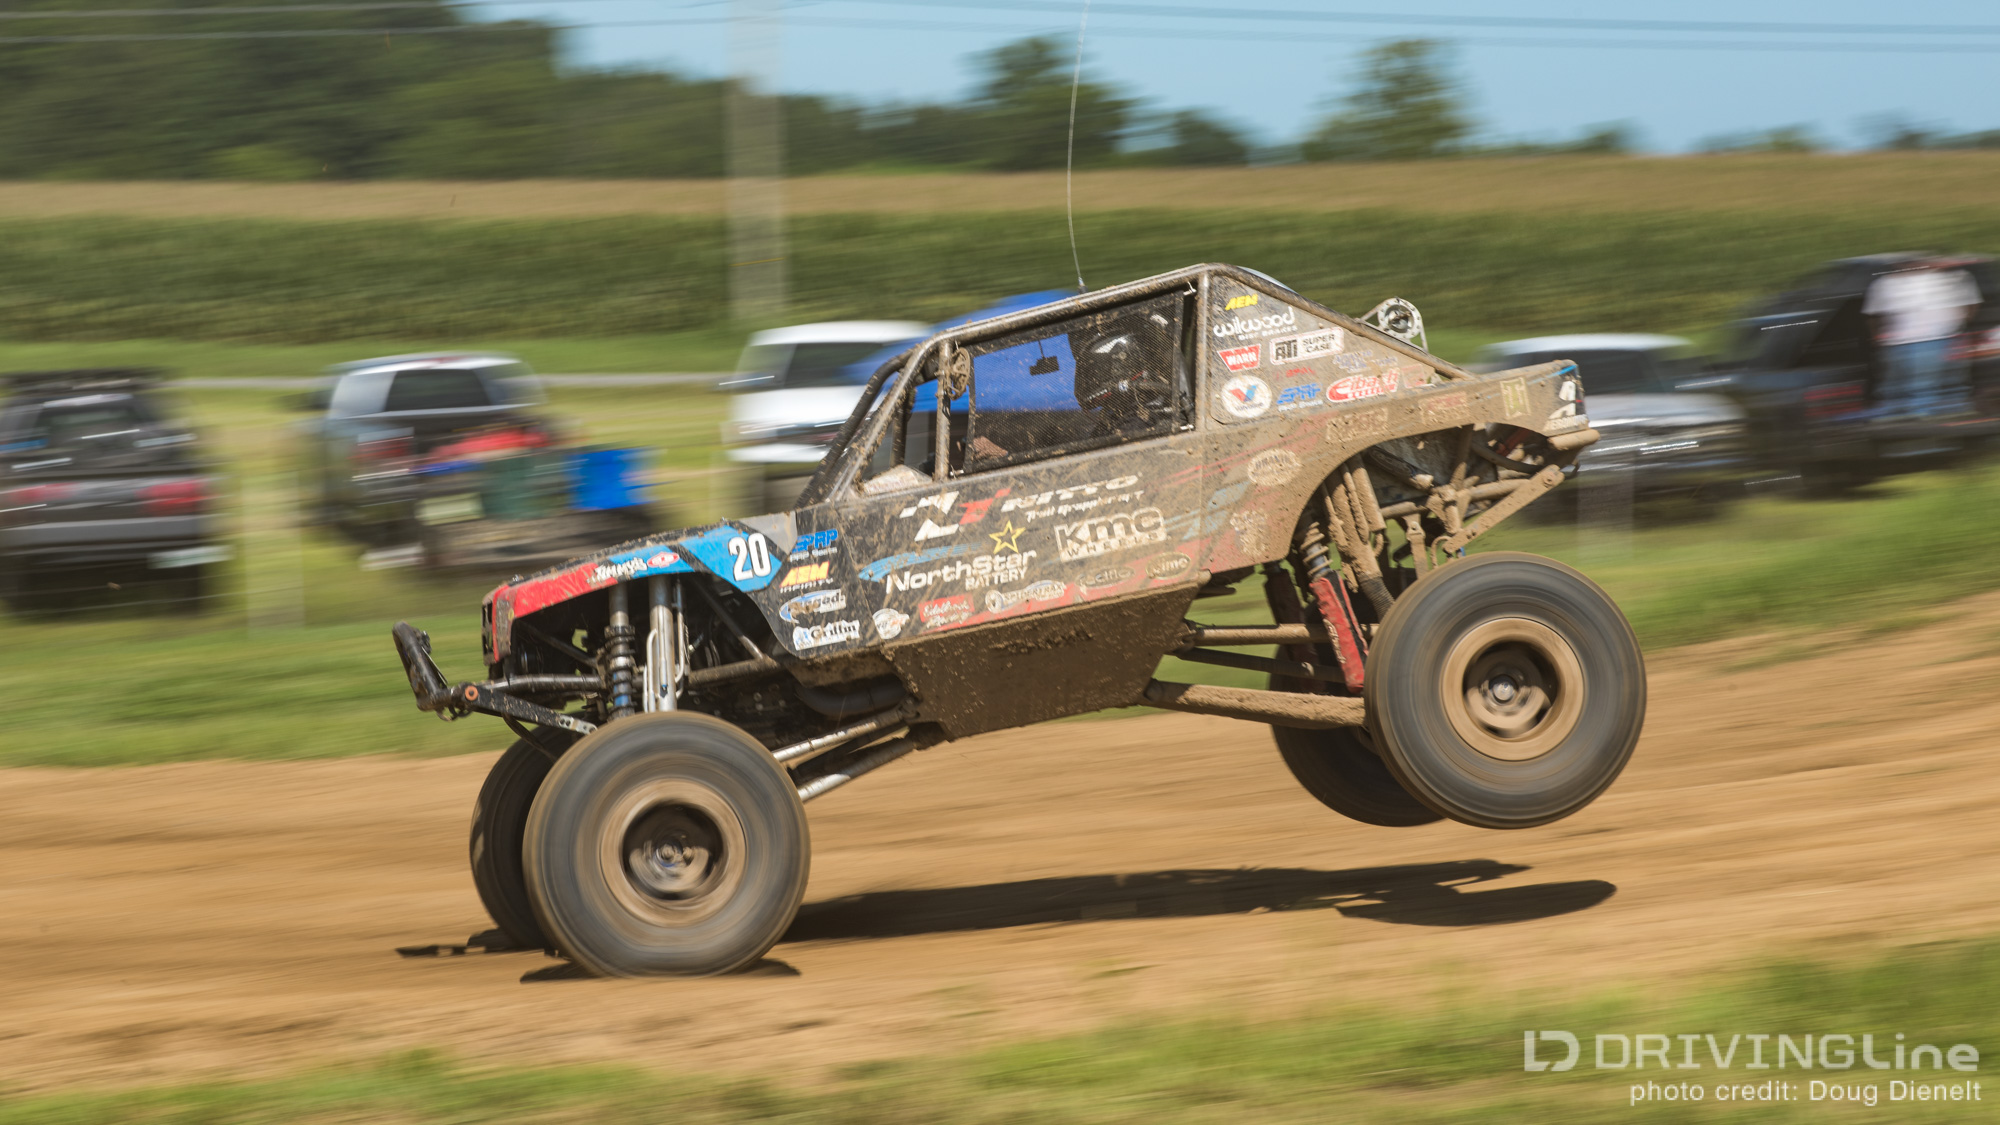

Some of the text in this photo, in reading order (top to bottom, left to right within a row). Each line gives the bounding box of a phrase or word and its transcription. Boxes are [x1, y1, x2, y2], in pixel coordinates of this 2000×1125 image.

[1225, 293, 1258, 311] AEM
[1213, 306, 1295, 338] wilwood
[1226, 351, 1258, 367] WARN
[728, 532, 771, 582] 20
[779, 560, 830, 588] AEM
[885, 550, 1038, 595] NorthStar
[965, 566, 1028, 591] BATTERY
[810, 622, 857, 641] Griffin
